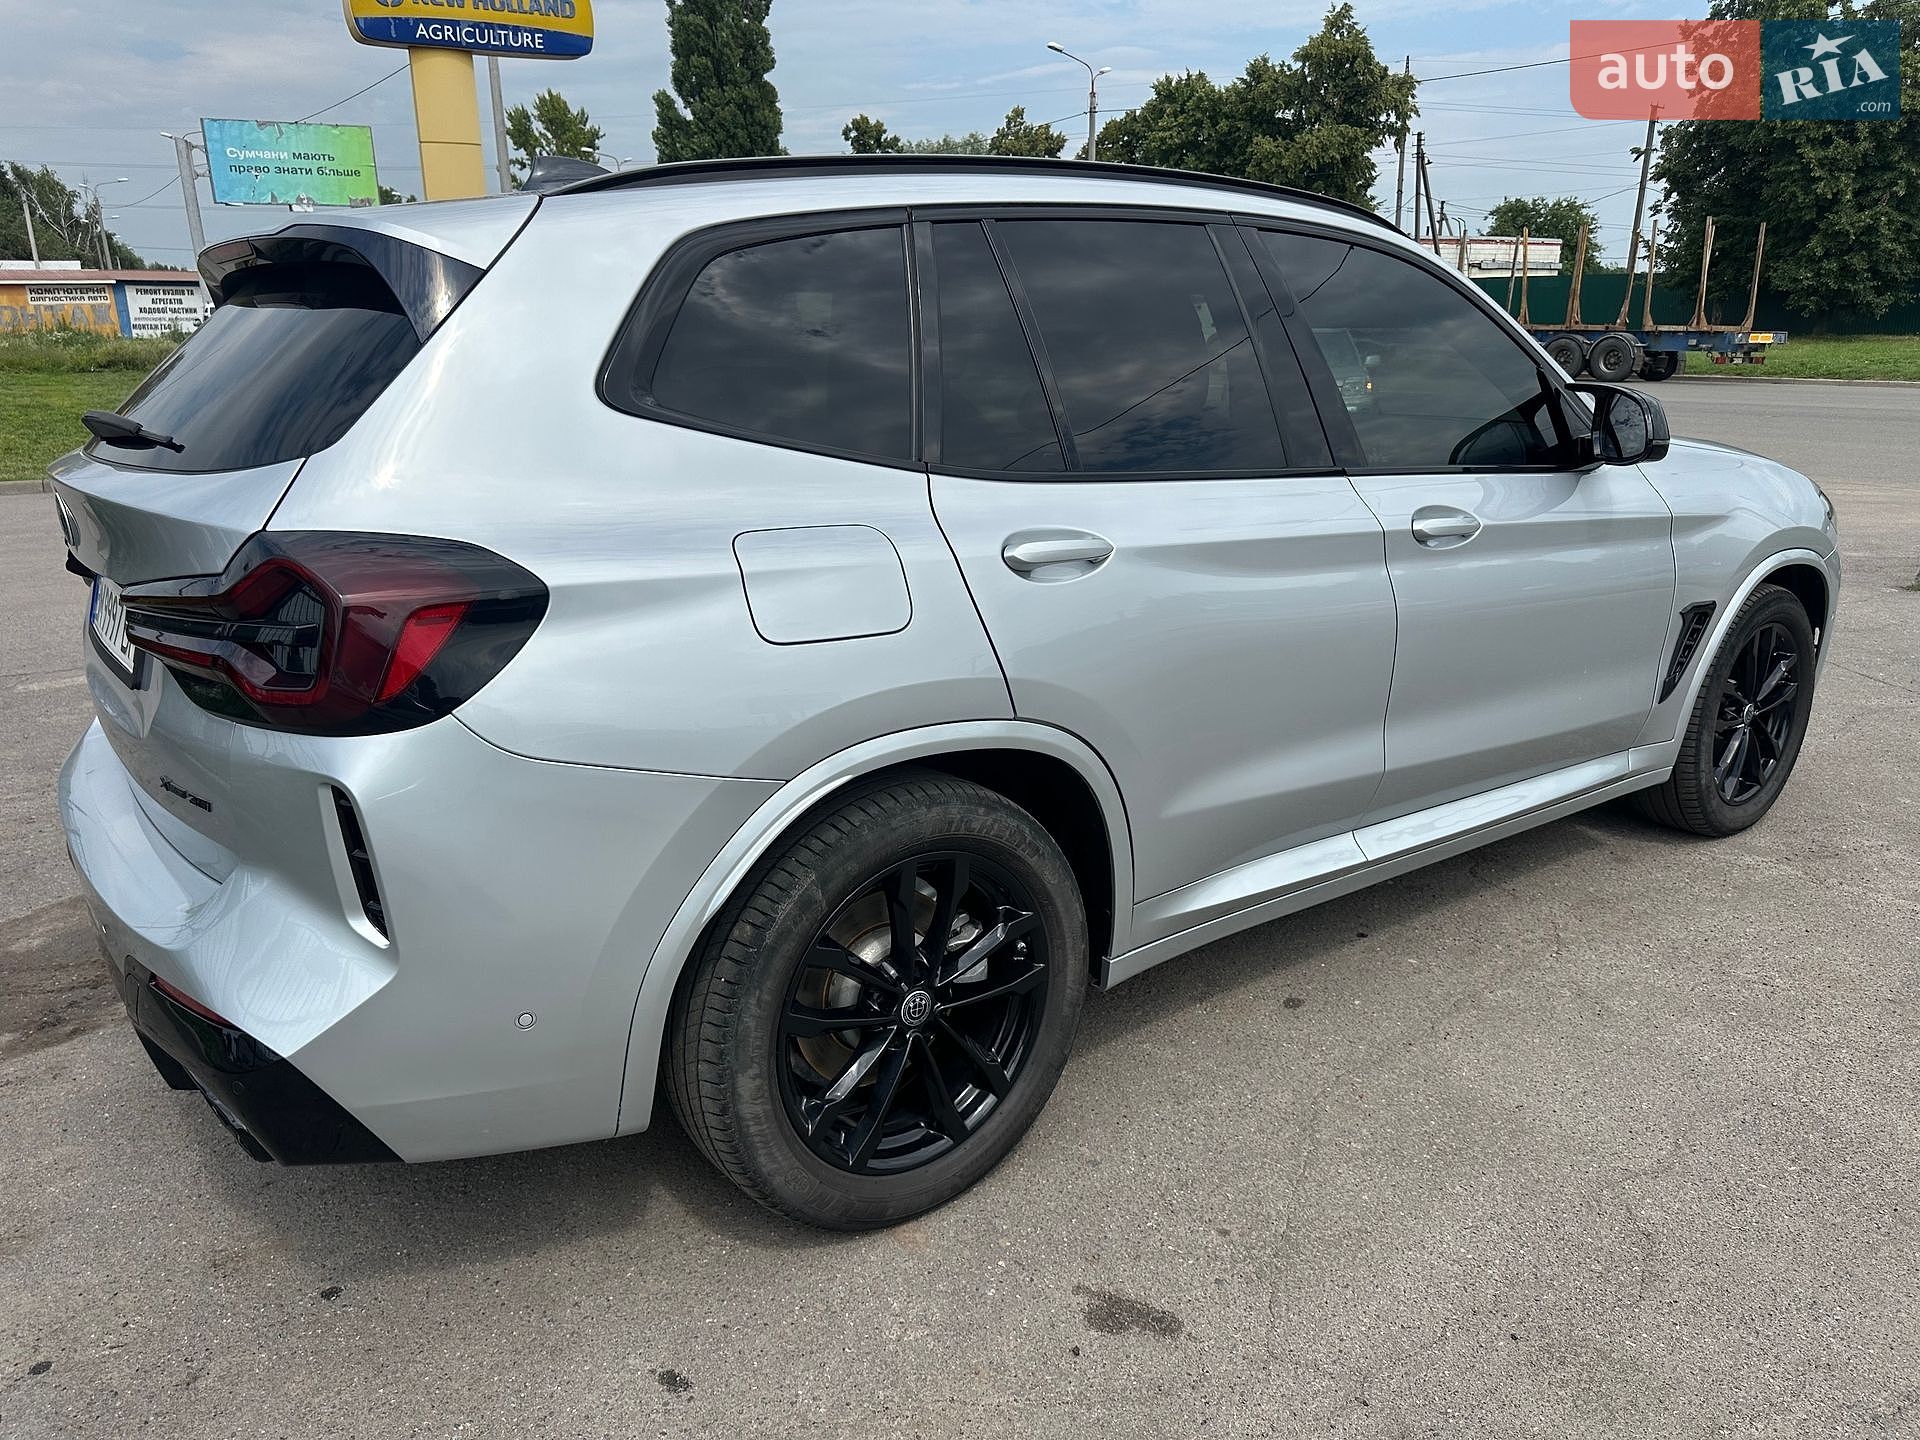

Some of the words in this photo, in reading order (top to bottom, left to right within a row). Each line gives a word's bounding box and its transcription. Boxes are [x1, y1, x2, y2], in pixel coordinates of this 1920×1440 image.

[415, 23, 544, 49] AGRICULTURE
[226, 147, 288, 160] Сумчани
[292, 152, 336, 162] мають
[229, 164, 270, 175] право
[274, 165, 313, 176] знати
[316, 166, 361, 178] більше
[135, 288, 161, 296] РЕМОНТ
